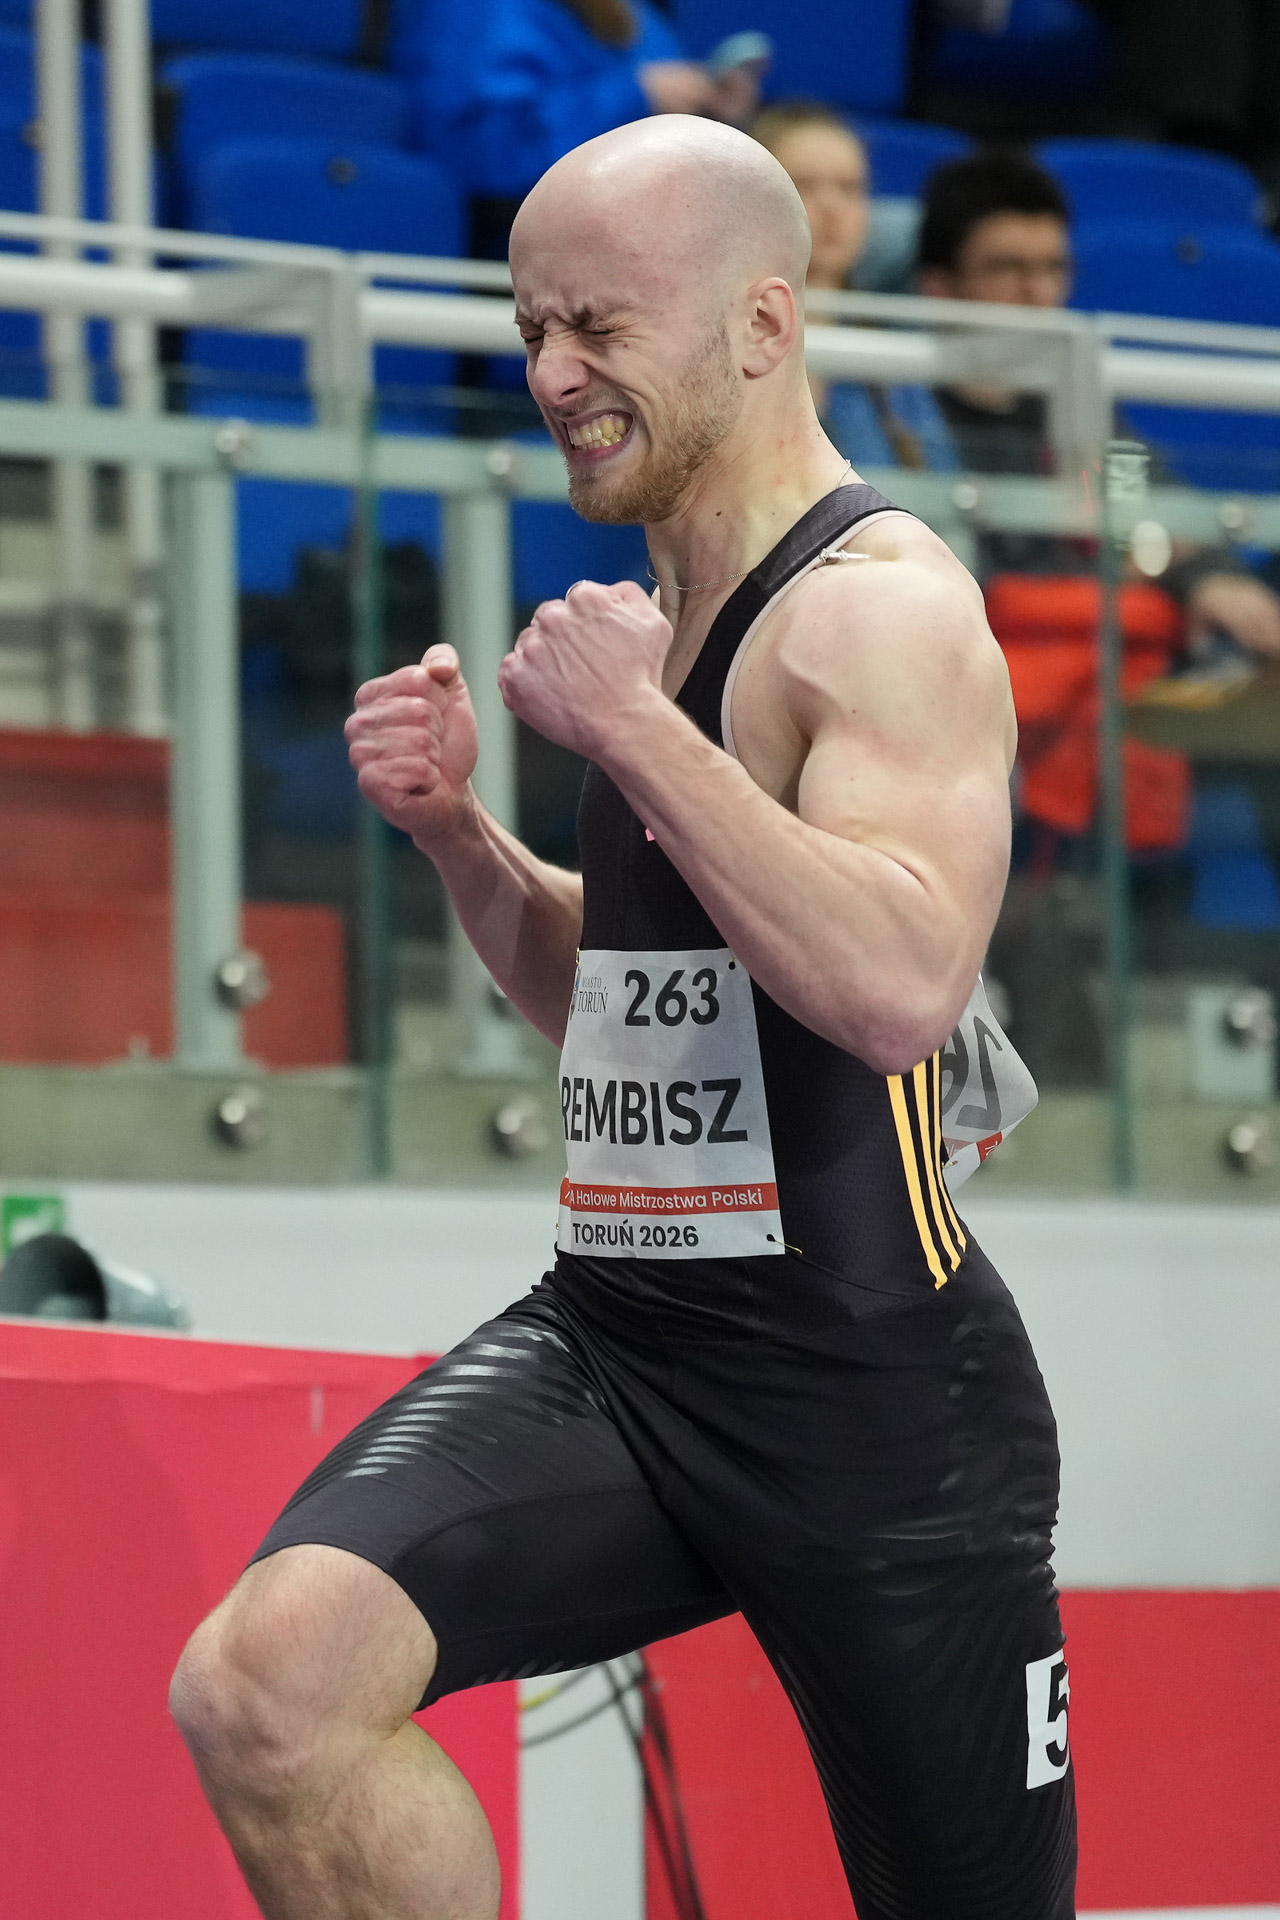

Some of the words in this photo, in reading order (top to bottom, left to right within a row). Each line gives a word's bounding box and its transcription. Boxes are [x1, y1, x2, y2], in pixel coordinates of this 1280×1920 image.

[577, 986, 608, 1014] TORUŃ
[624, 968, 720, 1027] 263
[560, 1076, 749, 1146] REMBISZ
[576, 1190, 617, 1206] Halowe
[619, 1191, 707, 1209] Mistrzostwa
[711, 1188, 763, 1206] Polski
[572, 1218, 634, 1247] TORUŃ
[639, 1225, 700, 1247] 2026
[1046, 1660, 1069, 1768] 5
